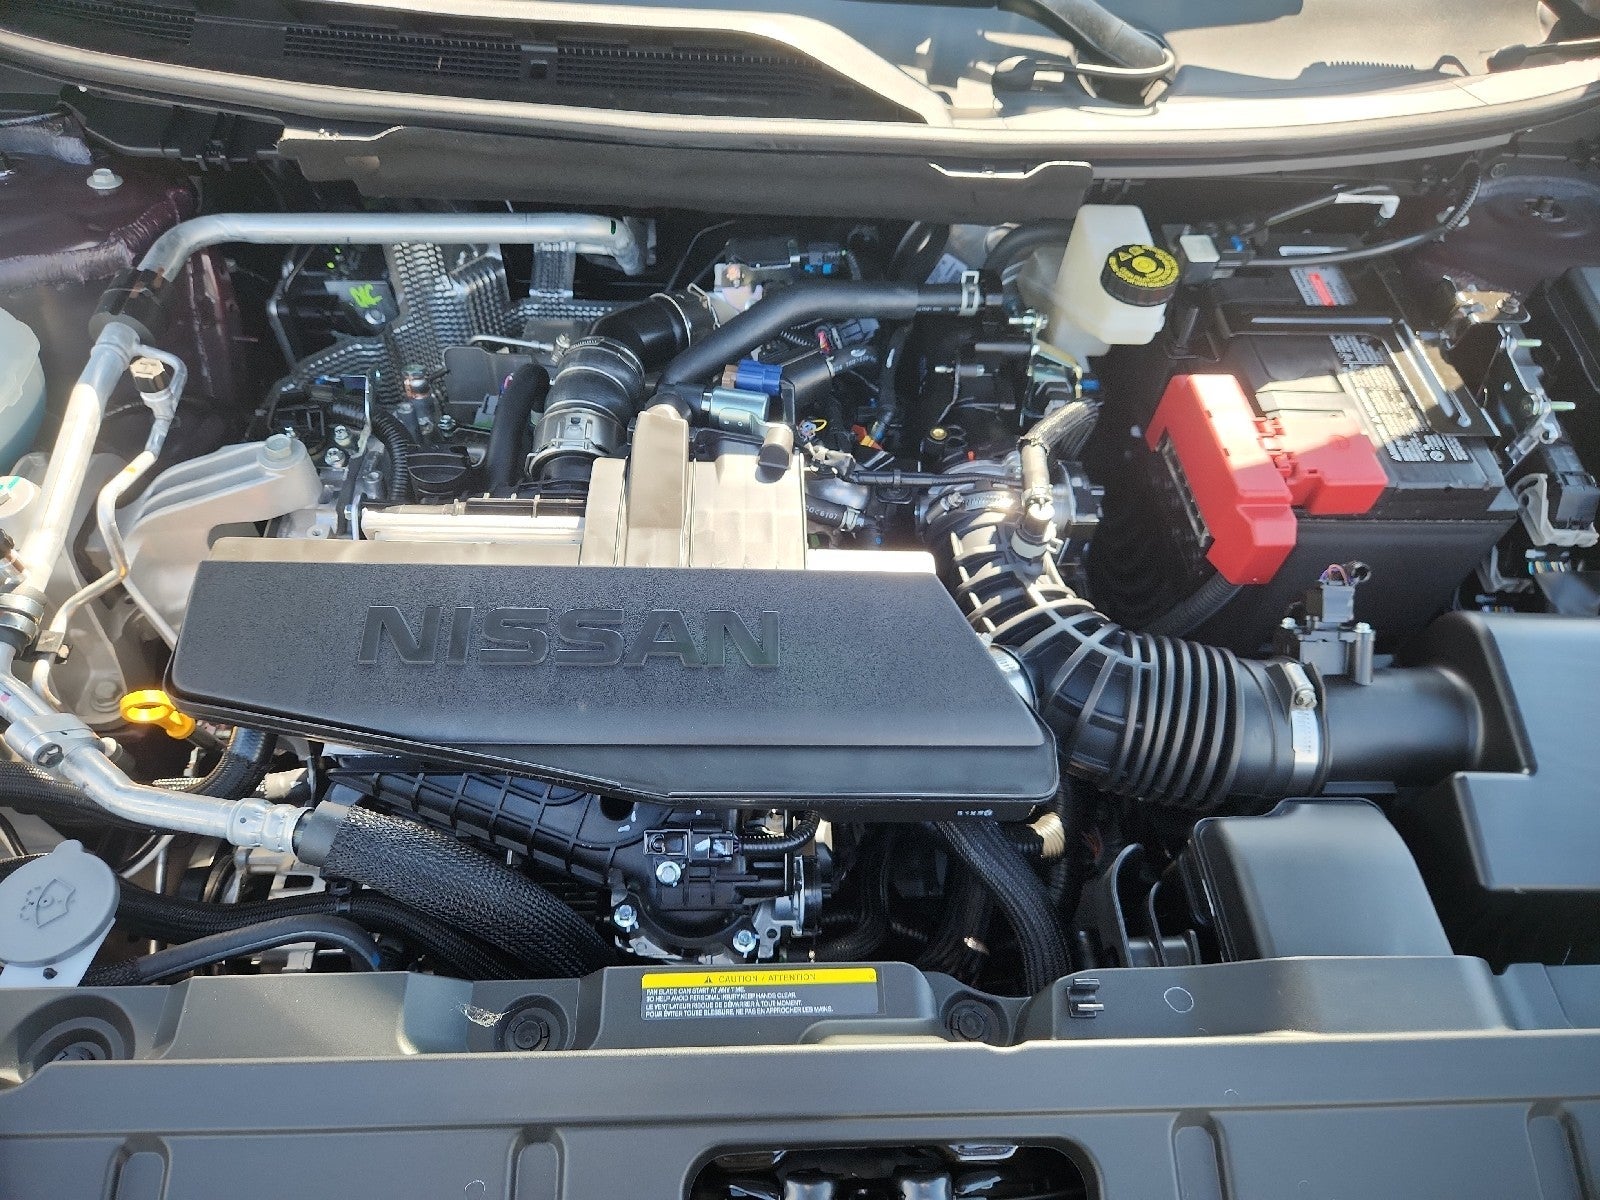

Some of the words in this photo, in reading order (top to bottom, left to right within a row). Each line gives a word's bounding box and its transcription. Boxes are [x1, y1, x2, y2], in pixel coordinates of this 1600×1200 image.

[358, 605, 780, 668] NISSAN
[718, 974, 758, 984] CAUTION
[768, 973, 816, 982] ATTENTION
